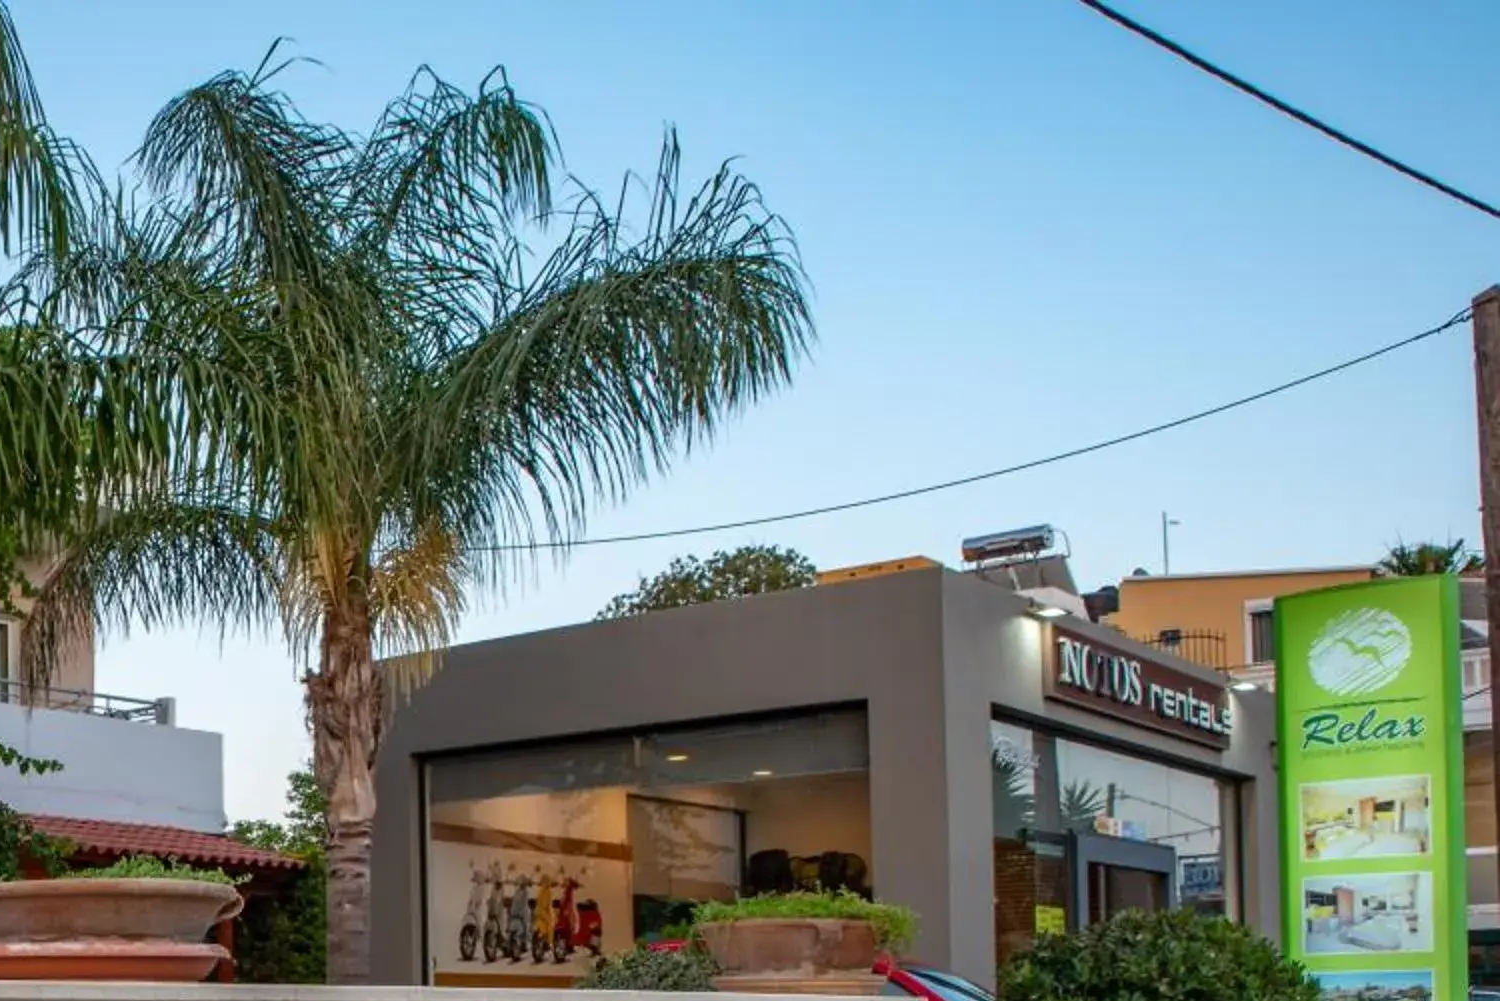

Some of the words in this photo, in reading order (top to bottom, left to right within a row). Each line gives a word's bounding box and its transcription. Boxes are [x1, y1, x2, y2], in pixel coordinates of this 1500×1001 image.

[1058, 635, 1143, 706] NOTOS
[1149, 683, 1235, 735] rentals
[1301, 707, 1426, 750] Relax
